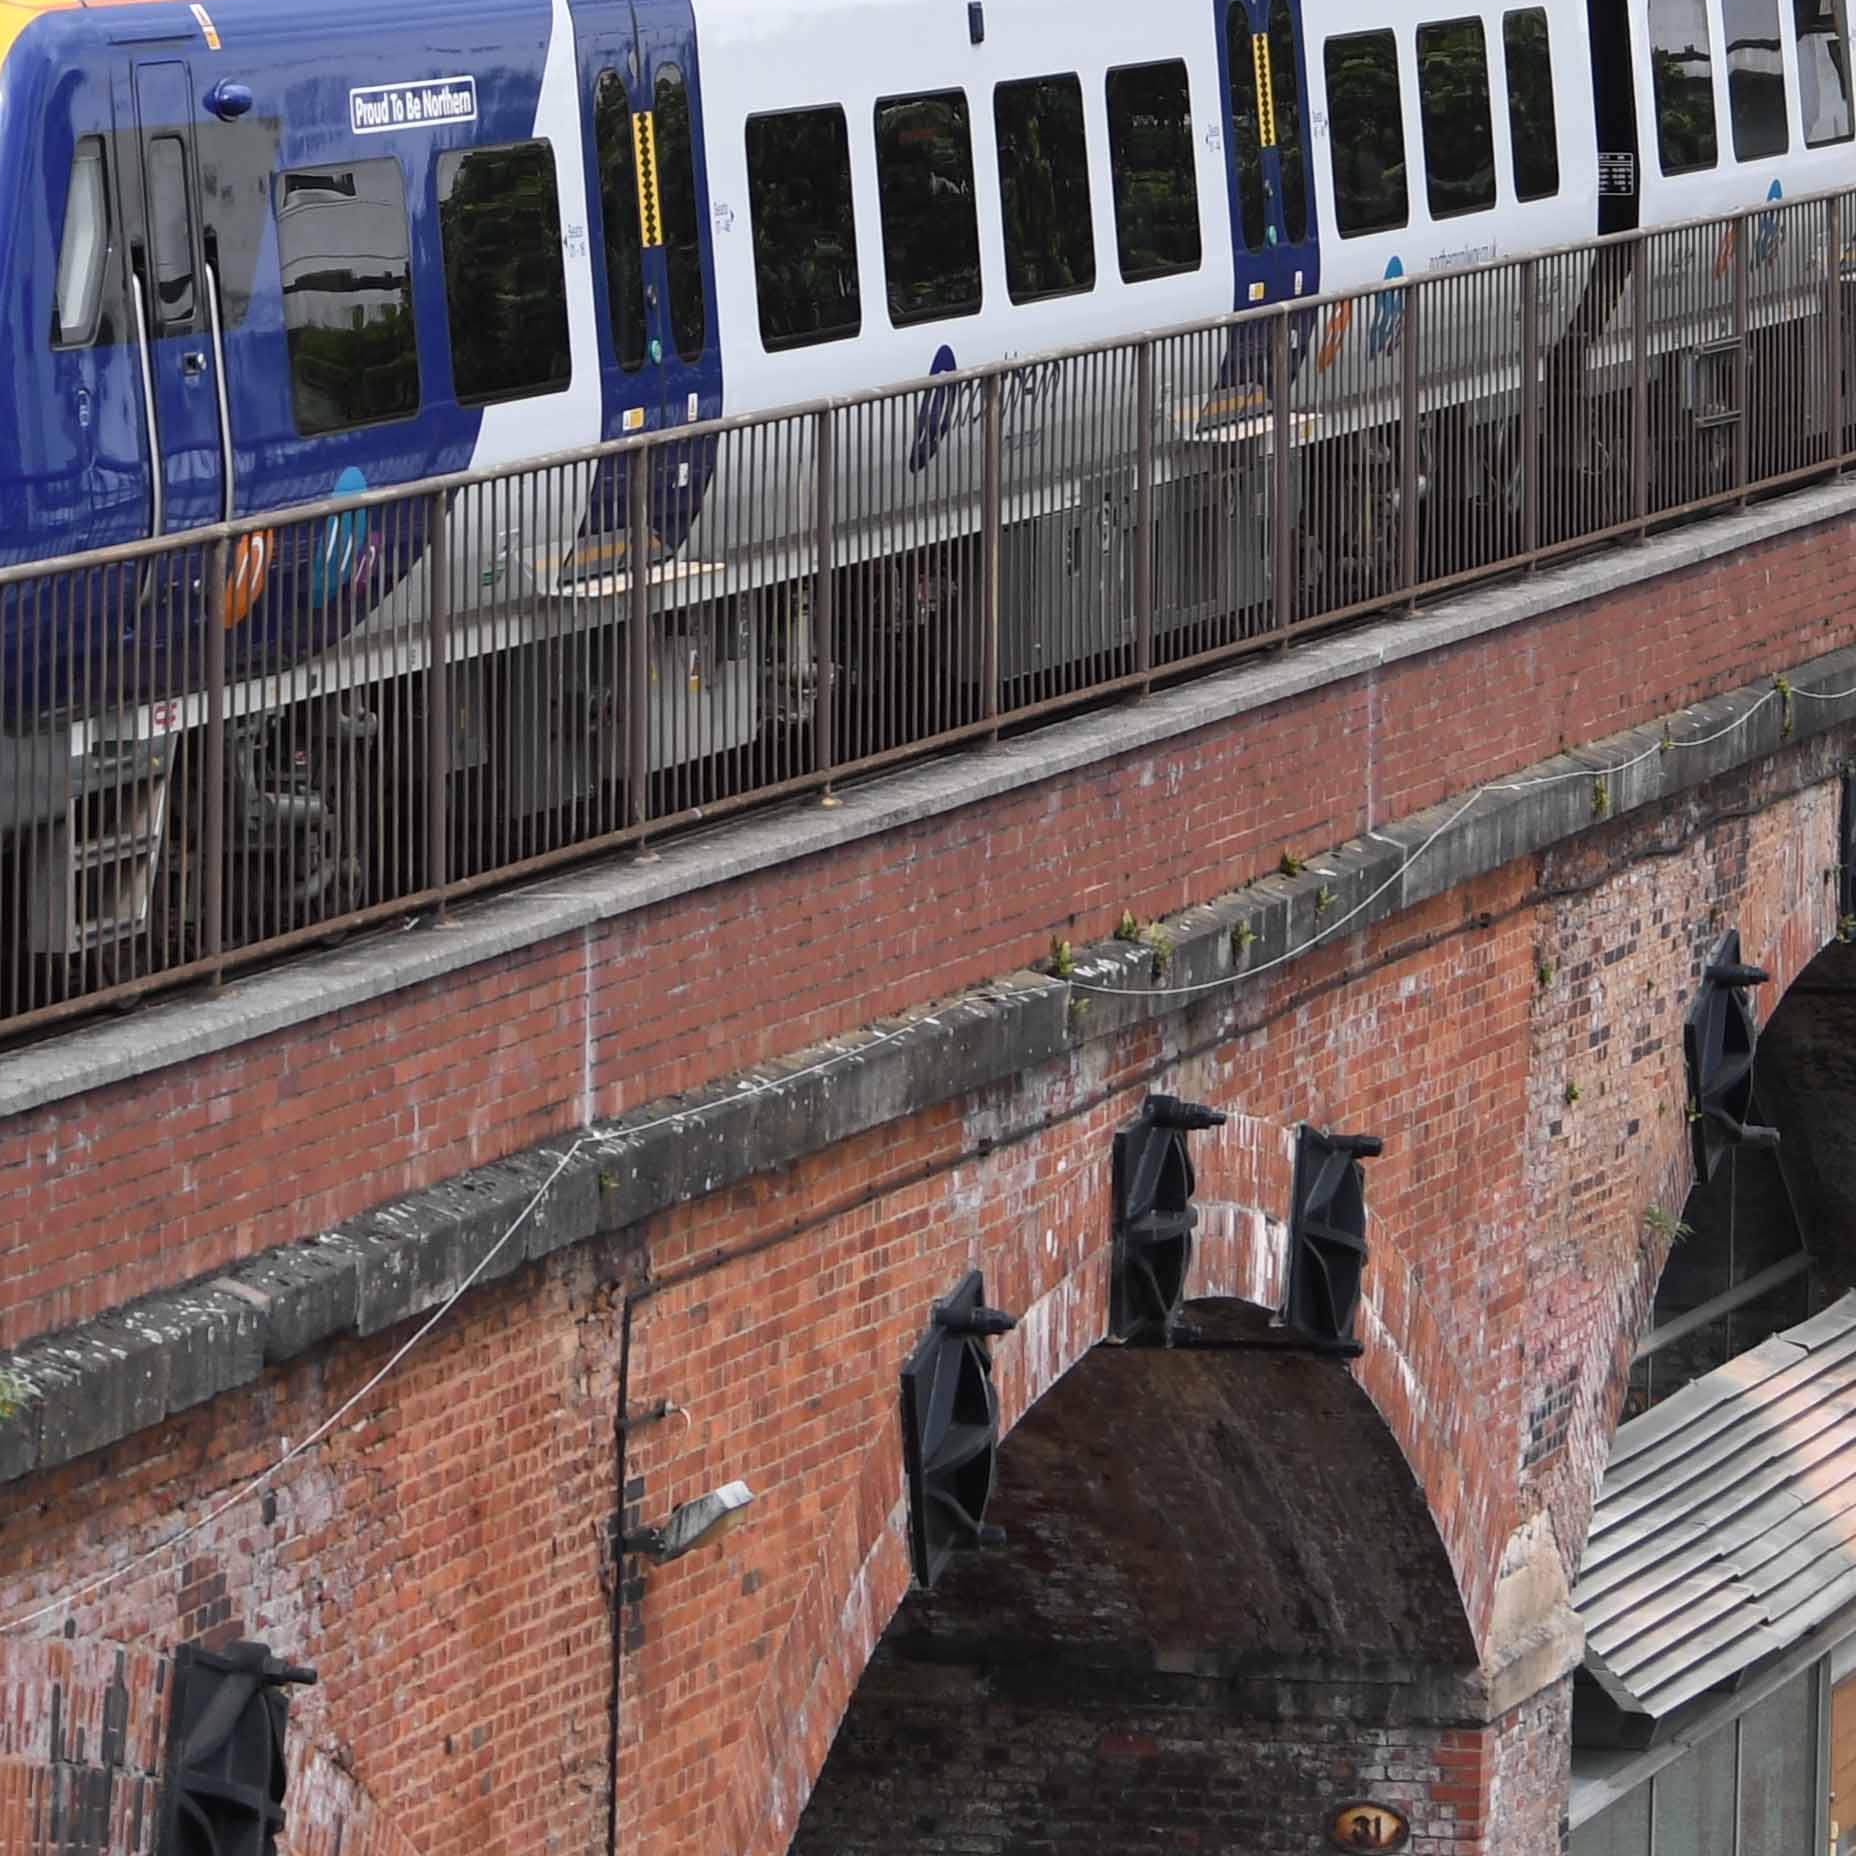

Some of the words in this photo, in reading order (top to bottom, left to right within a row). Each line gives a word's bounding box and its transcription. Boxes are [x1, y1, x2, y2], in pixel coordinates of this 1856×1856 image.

[354, 93, 390, 127] Proud
[390, 93, 405, 122] To
[405, 90, 422, 121] Be
[422, 85, 472, 118] Northern
